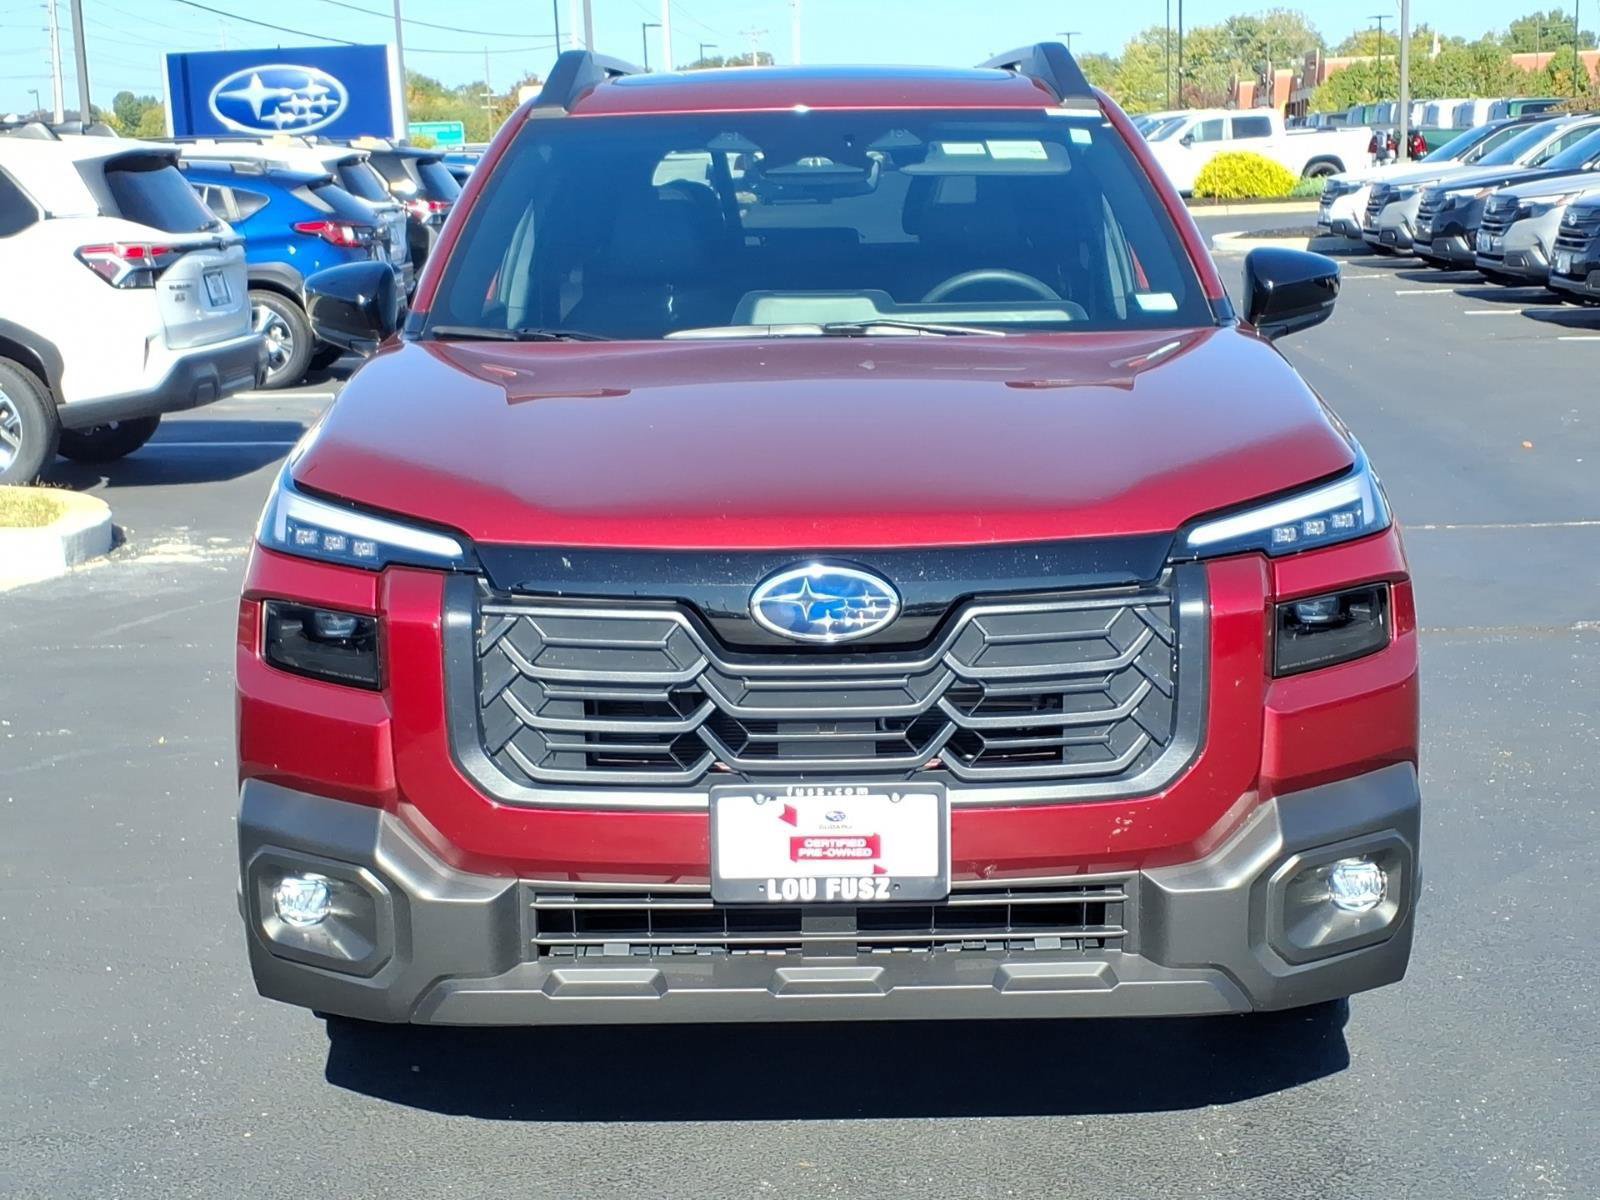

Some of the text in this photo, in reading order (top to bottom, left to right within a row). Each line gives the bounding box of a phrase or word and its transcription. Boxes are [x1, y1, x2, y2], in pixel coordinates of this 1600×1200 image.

[786, 786, 869, 796] fusz.com
[804, 838, 867, 848] CERTIFIED
[798, 847, 873, 857] PRE-OWNED
[767, 877, 891, 901] LOU FUSZ
